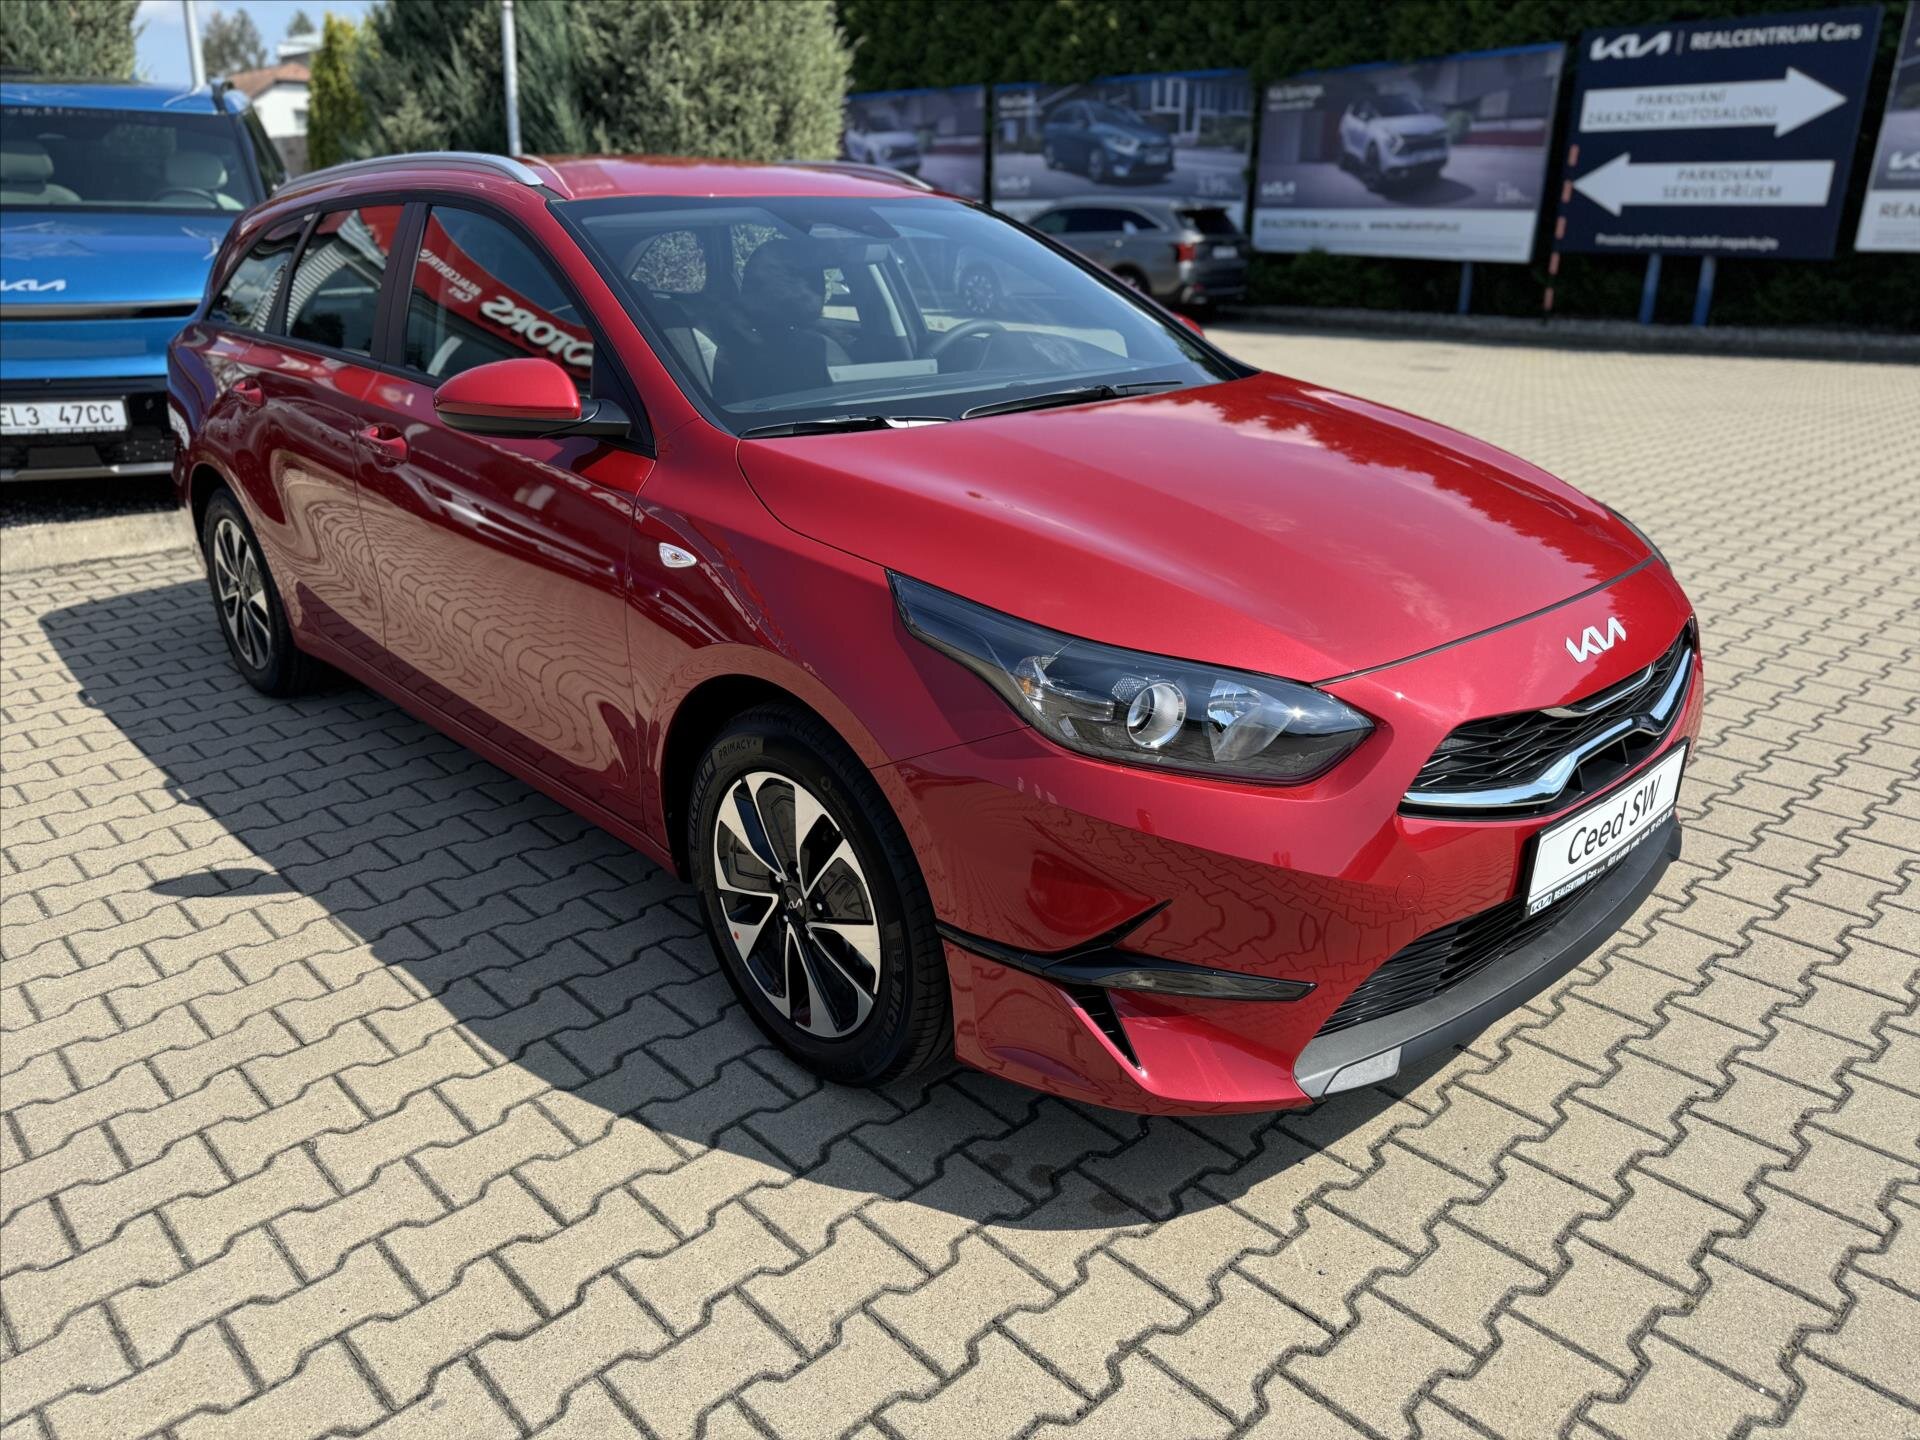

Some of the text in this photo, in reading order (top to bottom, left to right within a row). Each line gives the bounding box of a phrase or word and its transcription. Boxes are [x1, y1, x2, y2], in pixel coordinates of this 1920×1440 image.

[1589, 22, 1863, 61] KIA REALCENTRUM Cars
[1635, 88, 1728, 105] PARKOVÁNÍ
[1670, 104, 1778, 122] AUTOSALONU
[1676, 165, 1773, 181] PARKOVÁNÍ
[1662, 185, 1717, 199] SERVIS
[59, 404, 114, 425] 47CC
[1566, 616, 1627, 663] KIA
[719, 738, 752, 758] PRIMACY
[1568, 800, 1627, 865] Ceed
[1629, 774, 1662, 826] SW
